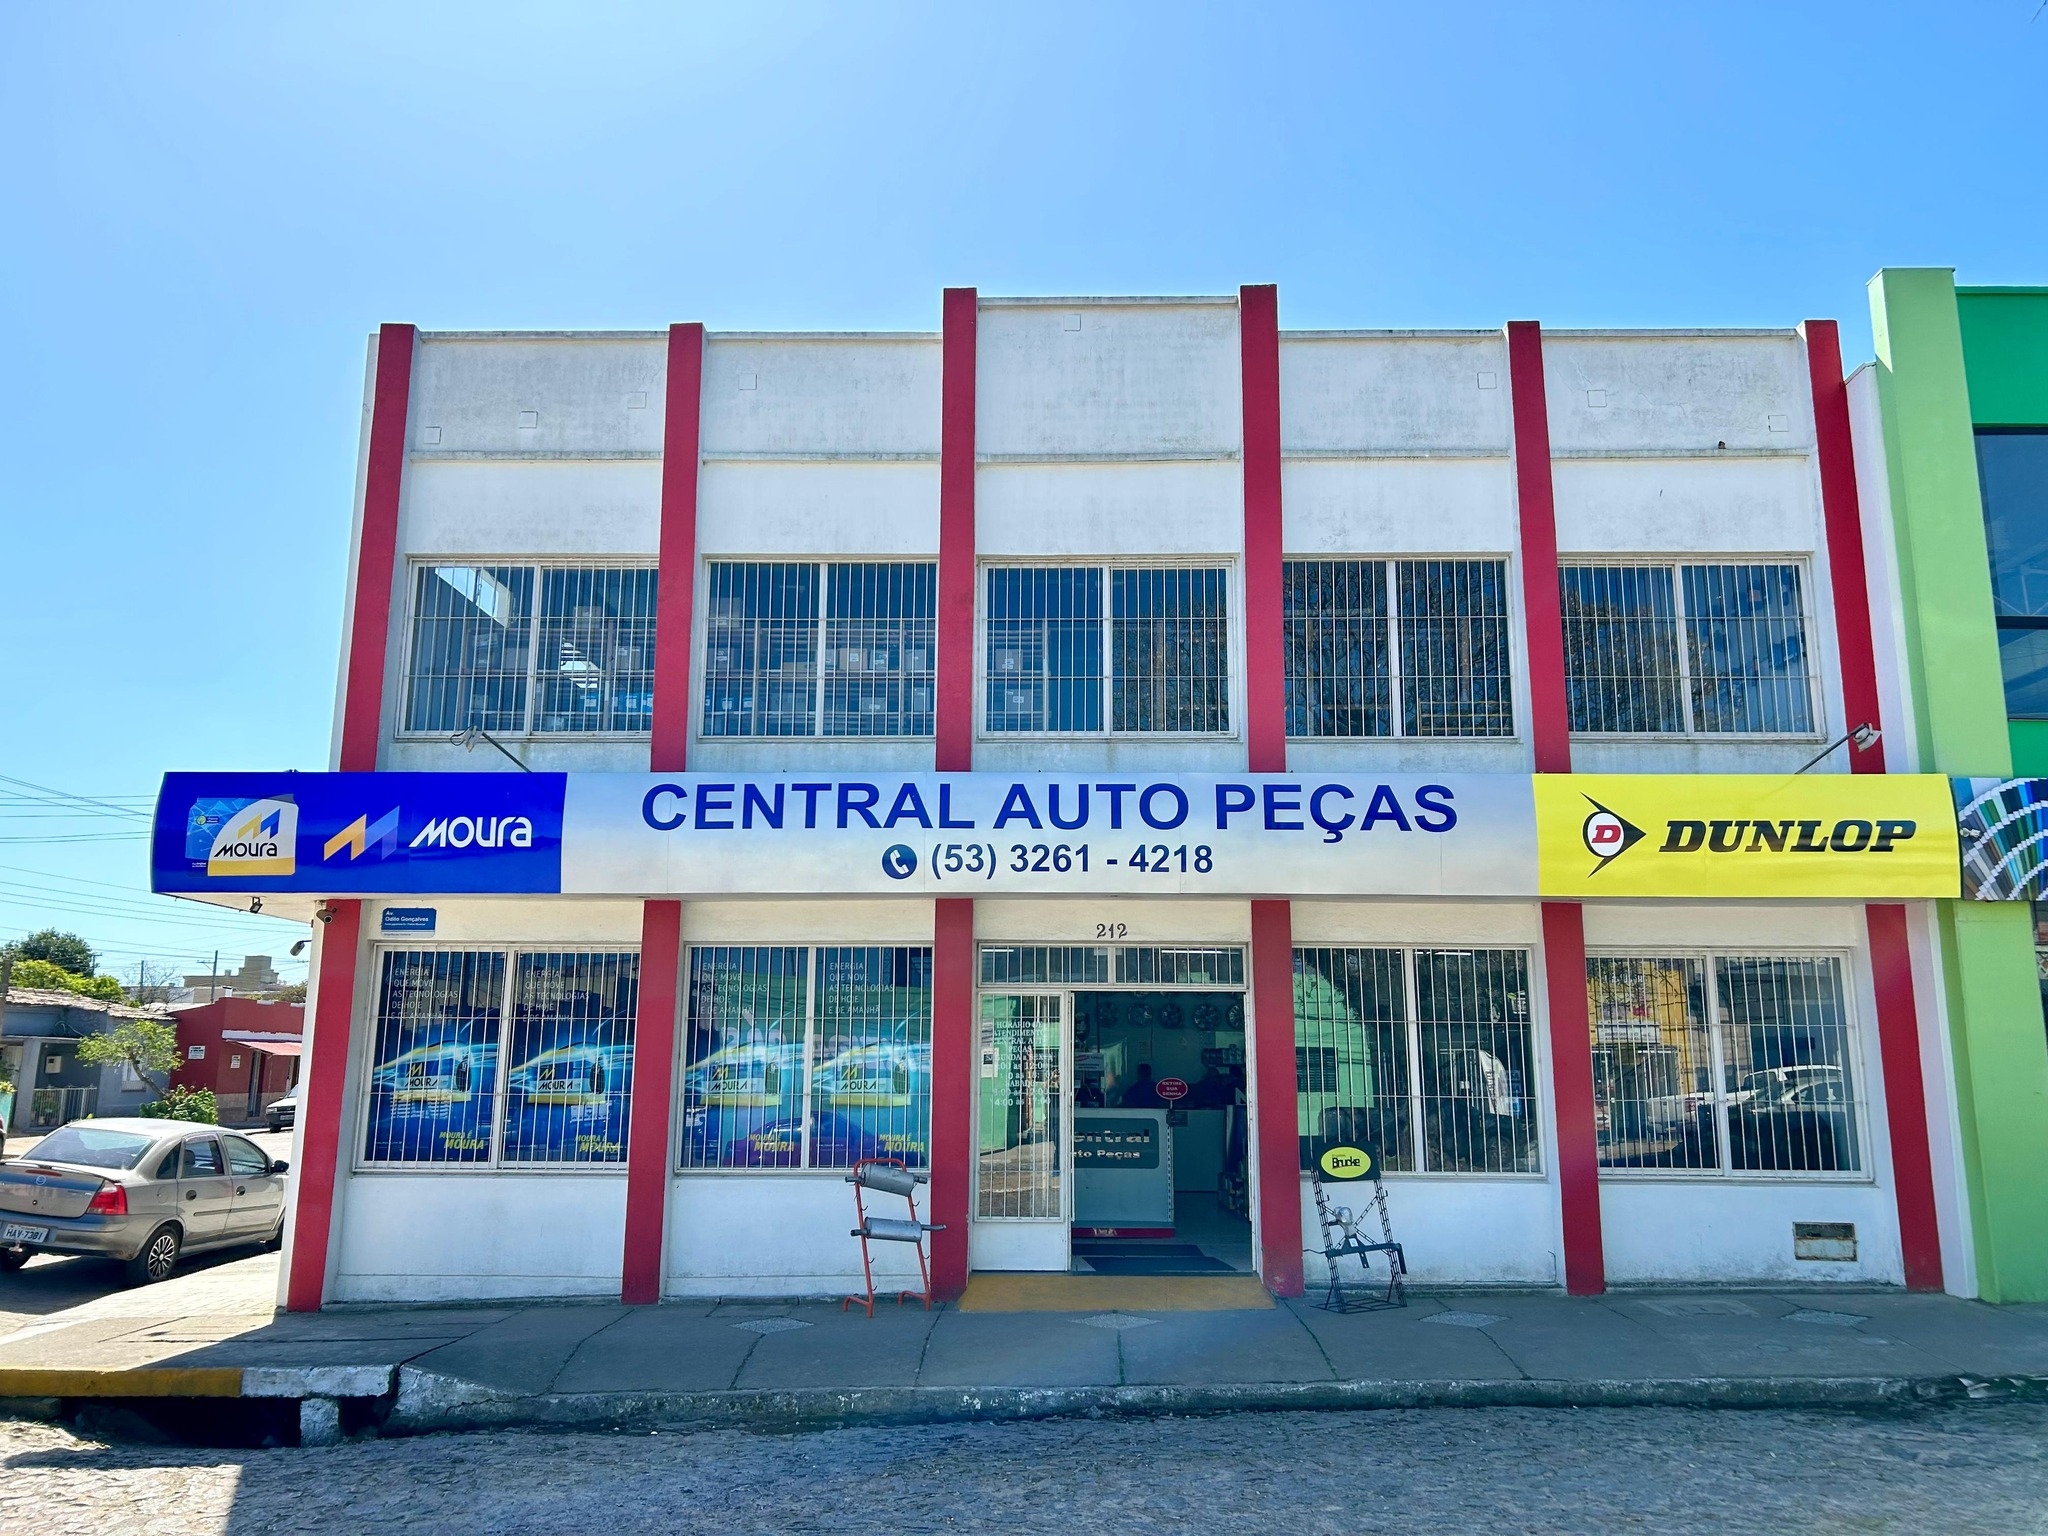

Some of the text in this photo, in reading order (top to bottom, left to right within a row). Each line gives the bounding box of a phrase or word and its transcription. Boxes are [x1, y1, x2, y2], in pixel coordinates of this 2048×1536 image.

[642, 783, 1458, 843] CENTRAL AUTO PEÇAS
[1592, 825, 1621, 843] D
[1659, 820, 1917, 852] DUNLOP
[931, 843, 997, 880] (53)
[1010, 844, 1089, 872] 3261
[1129, 844, 1213, 873] 4218
[1096, 923, 1128, 939] 212
[703, 962, 737, 970] ENERGIA
[829, 962, 864, 970] ENERGIA
[395, 968, 429, 976] ENERGIA
[526, 970, 560, 978] ENERGIA
[701, 984, 767, 992] AS TECNOOGAS
[829, 984, 894, 992] AS TECNOLOGIAS
[392, 990, 458, 998] AS TECNOOGAS
[537, 992, 589, 1000] TECNOLOGIAS
[714, 995, 731, 1003] HOE
[404, 1001, 422, 1009] HOE
[538, 1081, 573, 1090] MOURA
[841, 1081, 877, 1090] MOURA
[1074, 1129, 1150, 1143] entral
[444, 1140, 484, 1150] MOURA
[884, 1142, 925, 1152] MOURA
[1097, 1150, 1140, 1160] Peças
